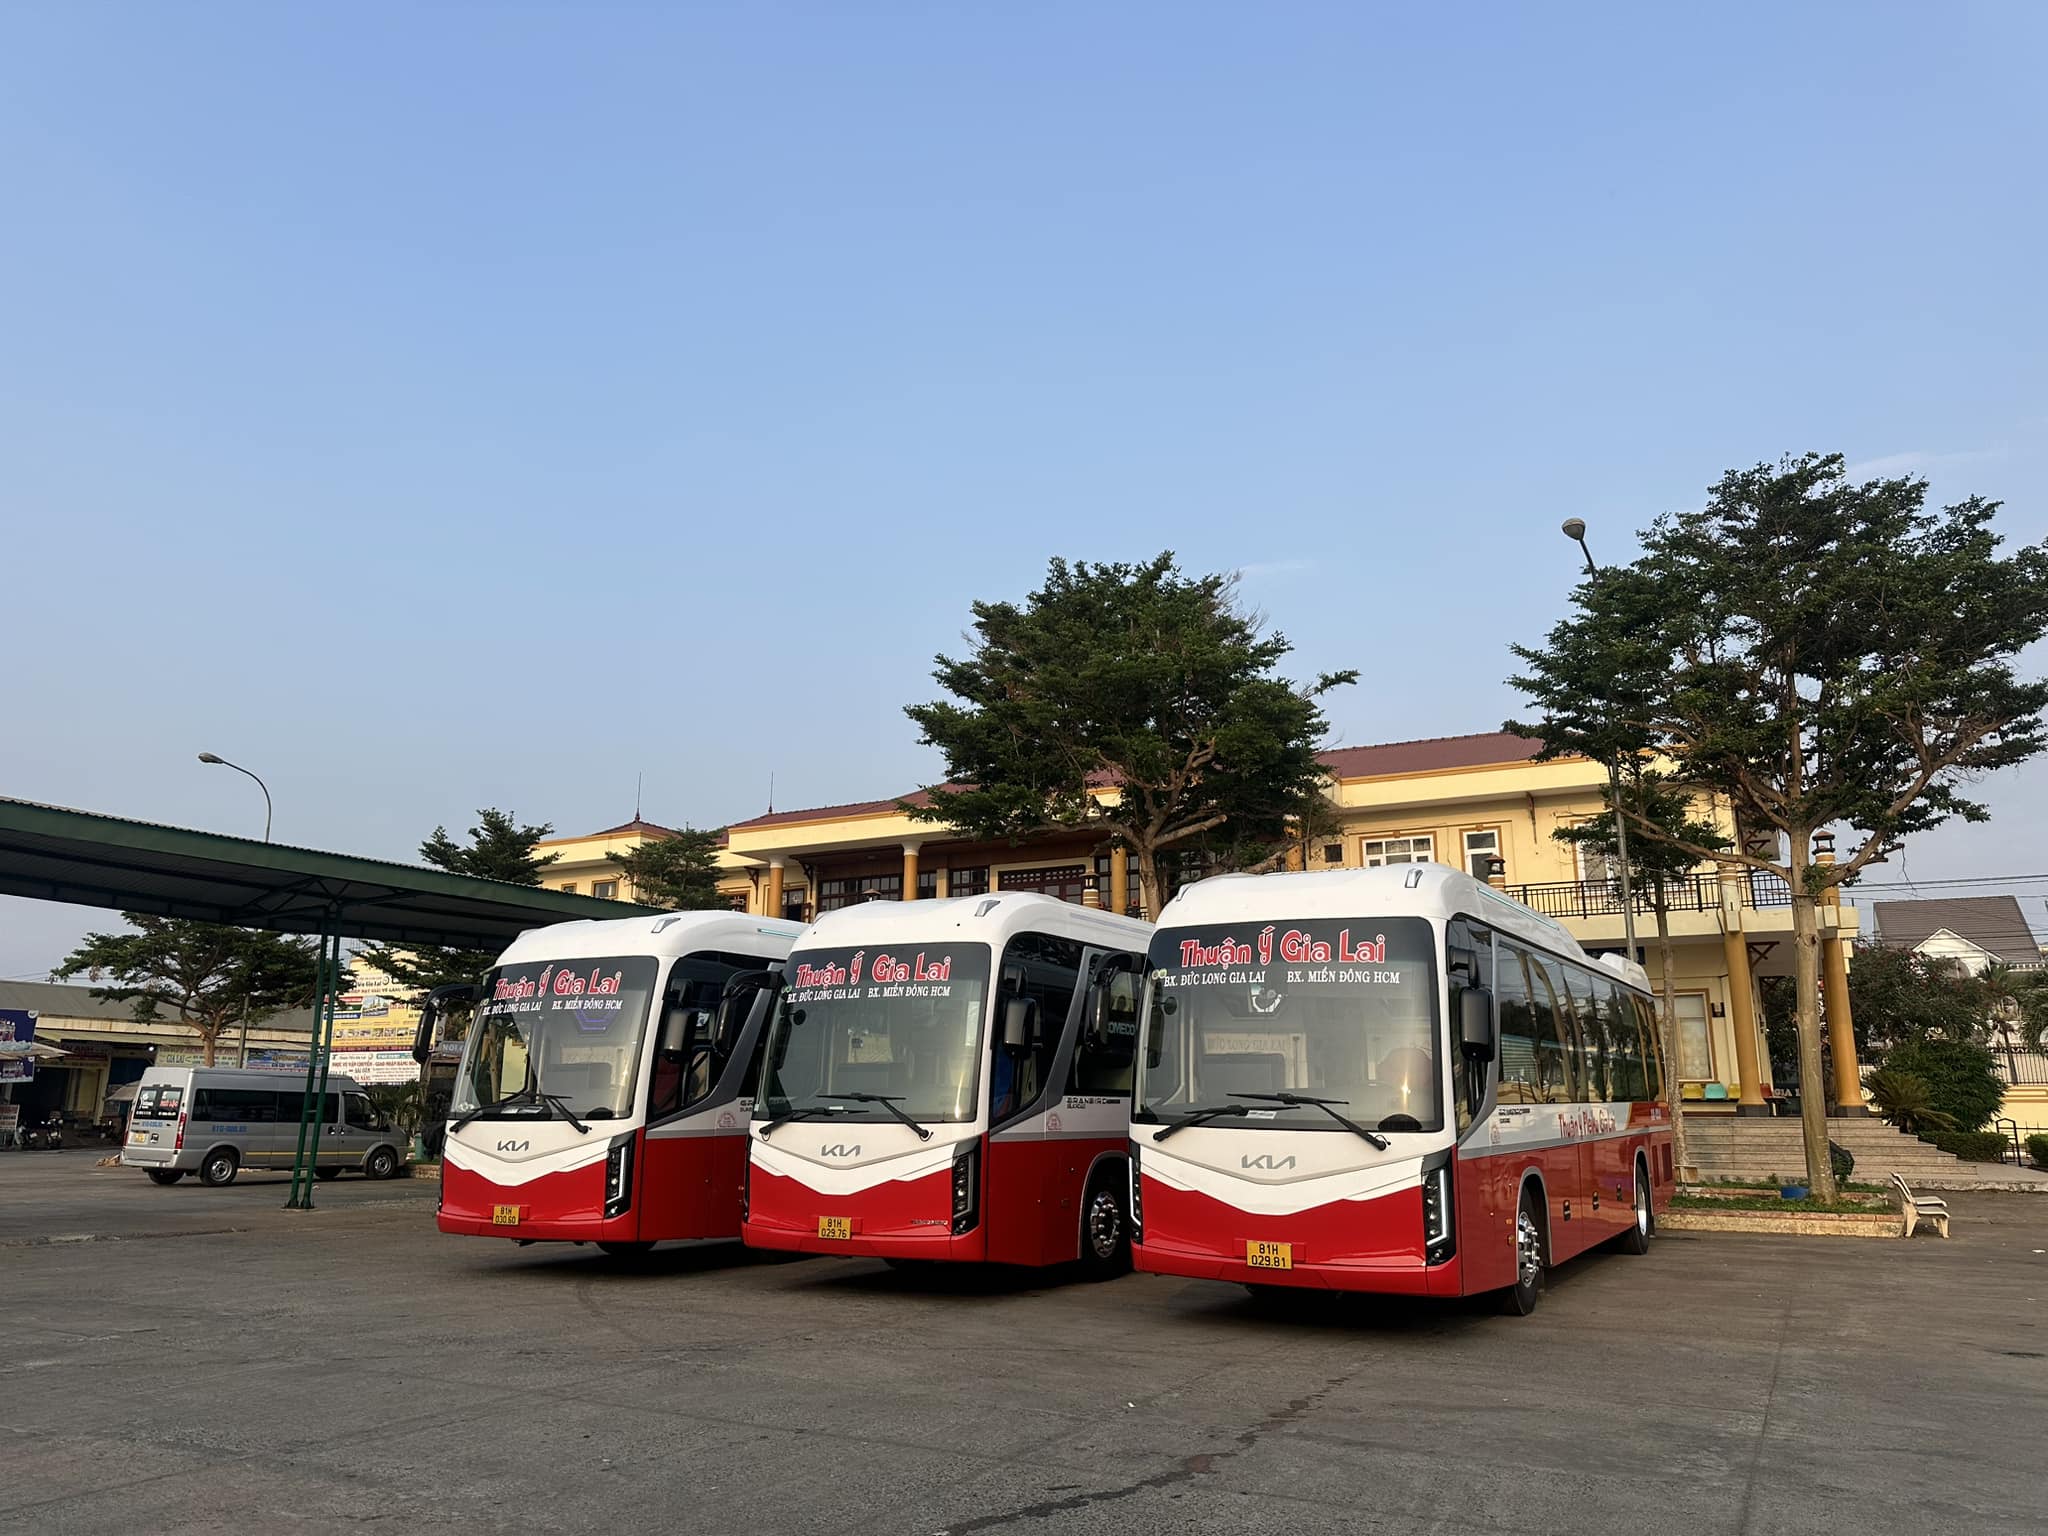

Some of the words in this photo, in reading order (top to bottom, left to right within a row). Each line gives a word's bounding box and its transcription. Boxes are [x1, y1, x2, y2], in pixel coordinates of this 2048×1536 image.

[1180, 937, 1251, 969] Thuận
[1280, 930, 1331, 963] Gia
[1339, 928, 1386, 963] Lai
[795, 962, 846, 989] Thuận
[871, 954, 910, 983] Gia
[913, 952, 951, 981] Lai
[1287, 970, 1304, 983] BX.
[1339, 968, 1371, 983] ĐÔNG
[1373, 971, 1400, 984] HCM
[1201, 972, 1226, 985] LONG
[1229, 971, 1247, 984] GIA
[1249, 970, 1266, 983] LAI
[493, 976, 535, 1001] Thuận
[554, 969, 586, 996] Gia
[588, 968, 622, 994] Lai
[814, 989, 832, 1001] LONG
[833, 988, 846, 999] GIA
[847, 987, 861, 998] LAI
[931, 986, 951, 997] HCM
[531, 1001, 543, 1011] LAI
[604, 1000, 624, 1010] HCM
[497, 1140, 529, 1151] KIA
[821, 1144, 861, 1156] KIA
[1241, 1154, 1296, 1170] KIA
[827, 1218, 842, 1228] 81H
[1259, 1243, 1278, 1255] 81H
[1251, 1255, 1286, 1267] 029.81
